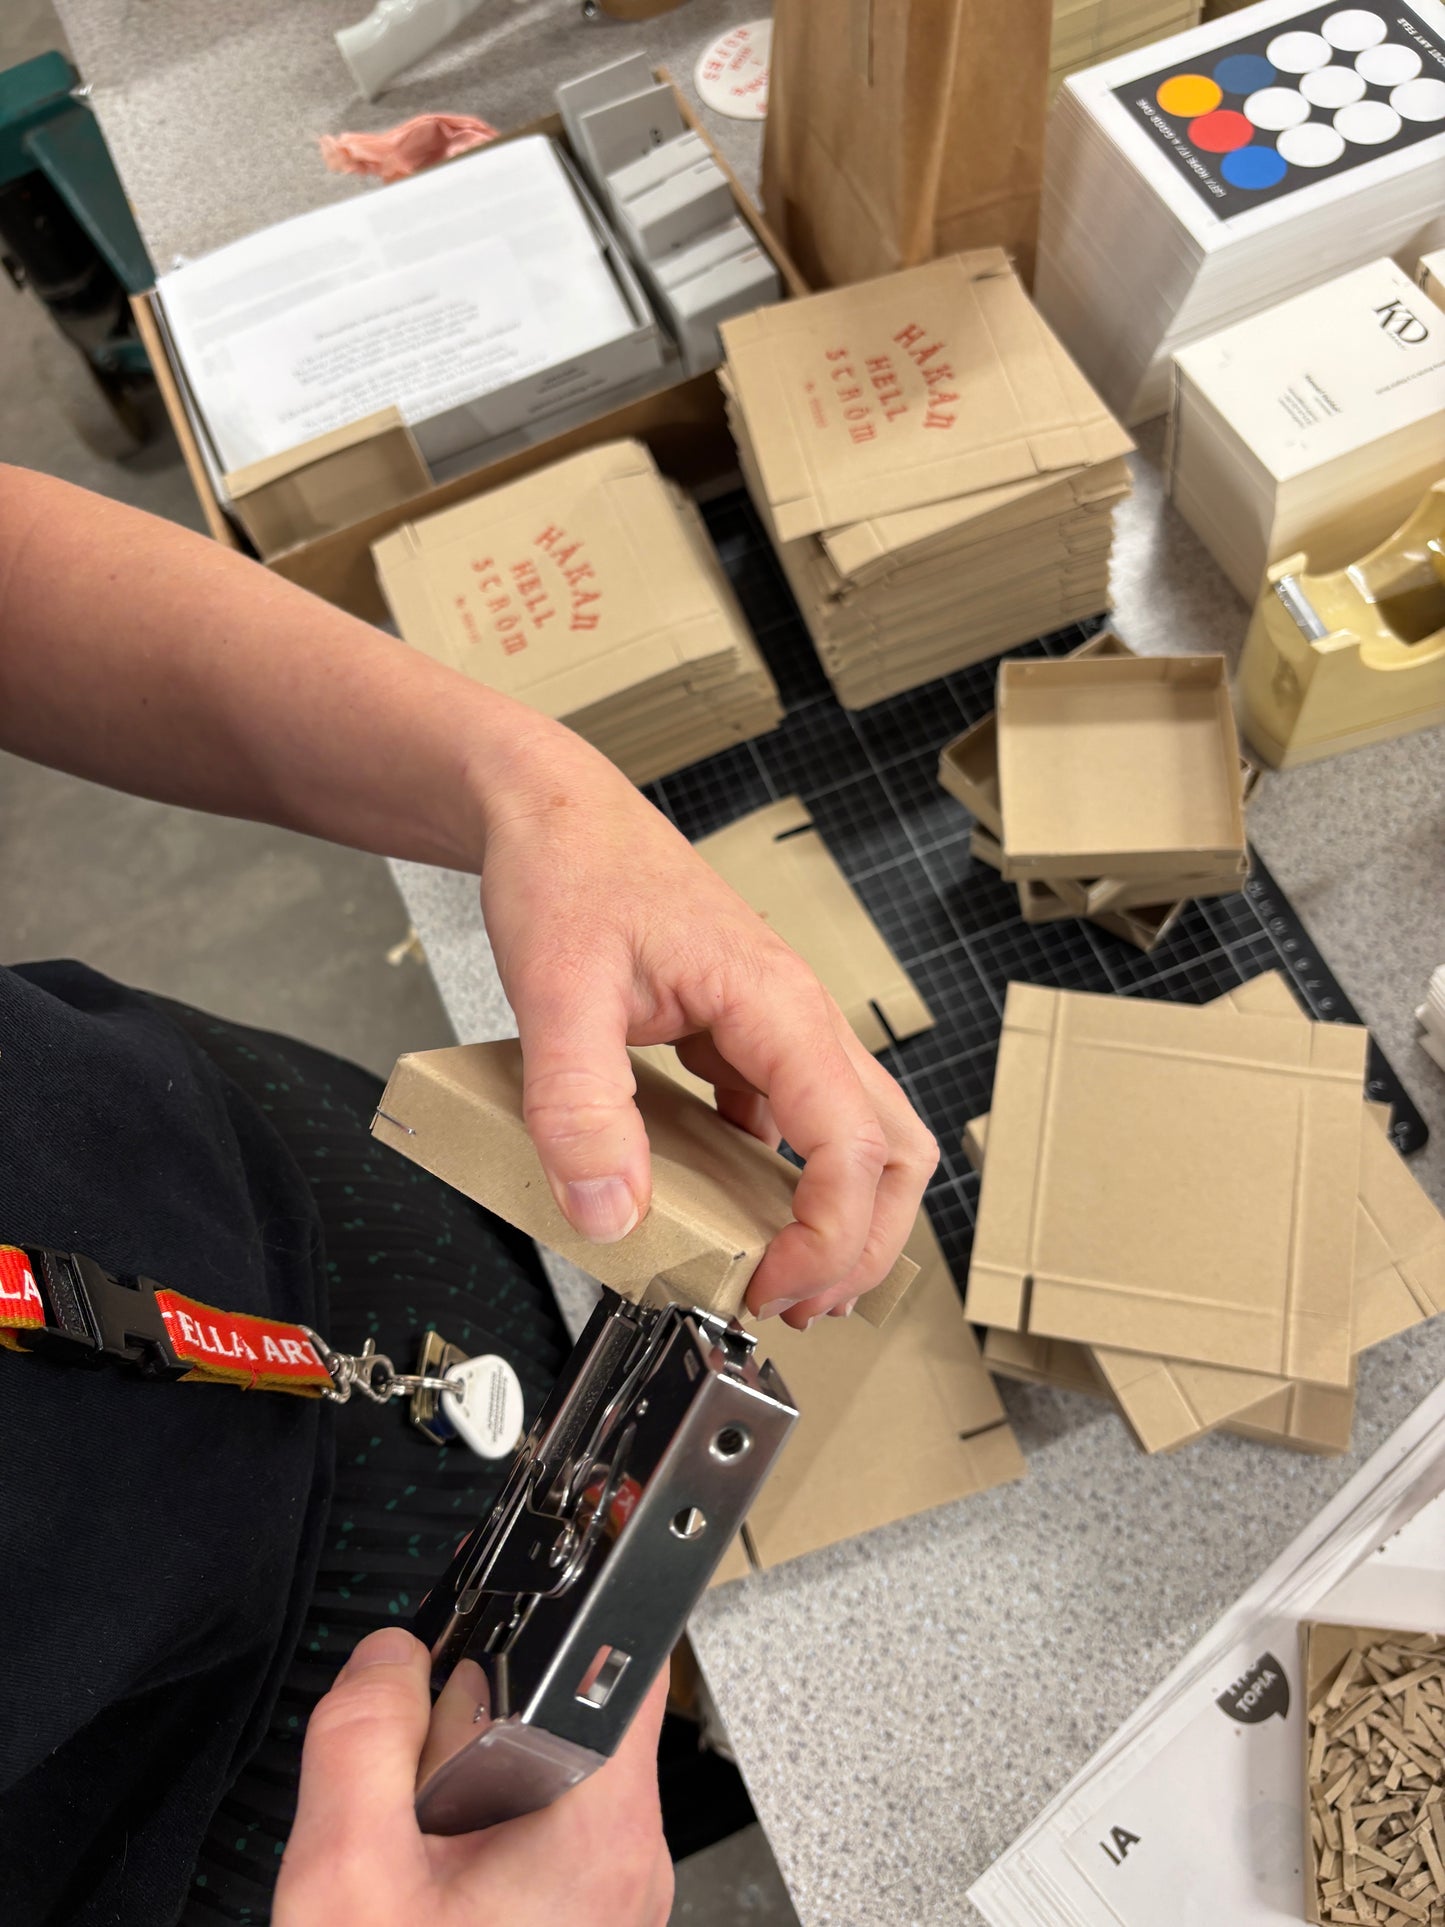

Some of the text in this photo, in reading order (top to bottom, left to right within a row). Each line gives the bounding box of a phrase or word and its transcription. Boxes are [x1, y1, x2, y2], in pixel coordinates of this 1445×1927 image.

[864, 355, 908, 423] HELL
[510, 559, 556, 630] HELL
[161, 1310, 259, 1361] ELLA
[1235, 1669, 1279, 1714] TOPIA
